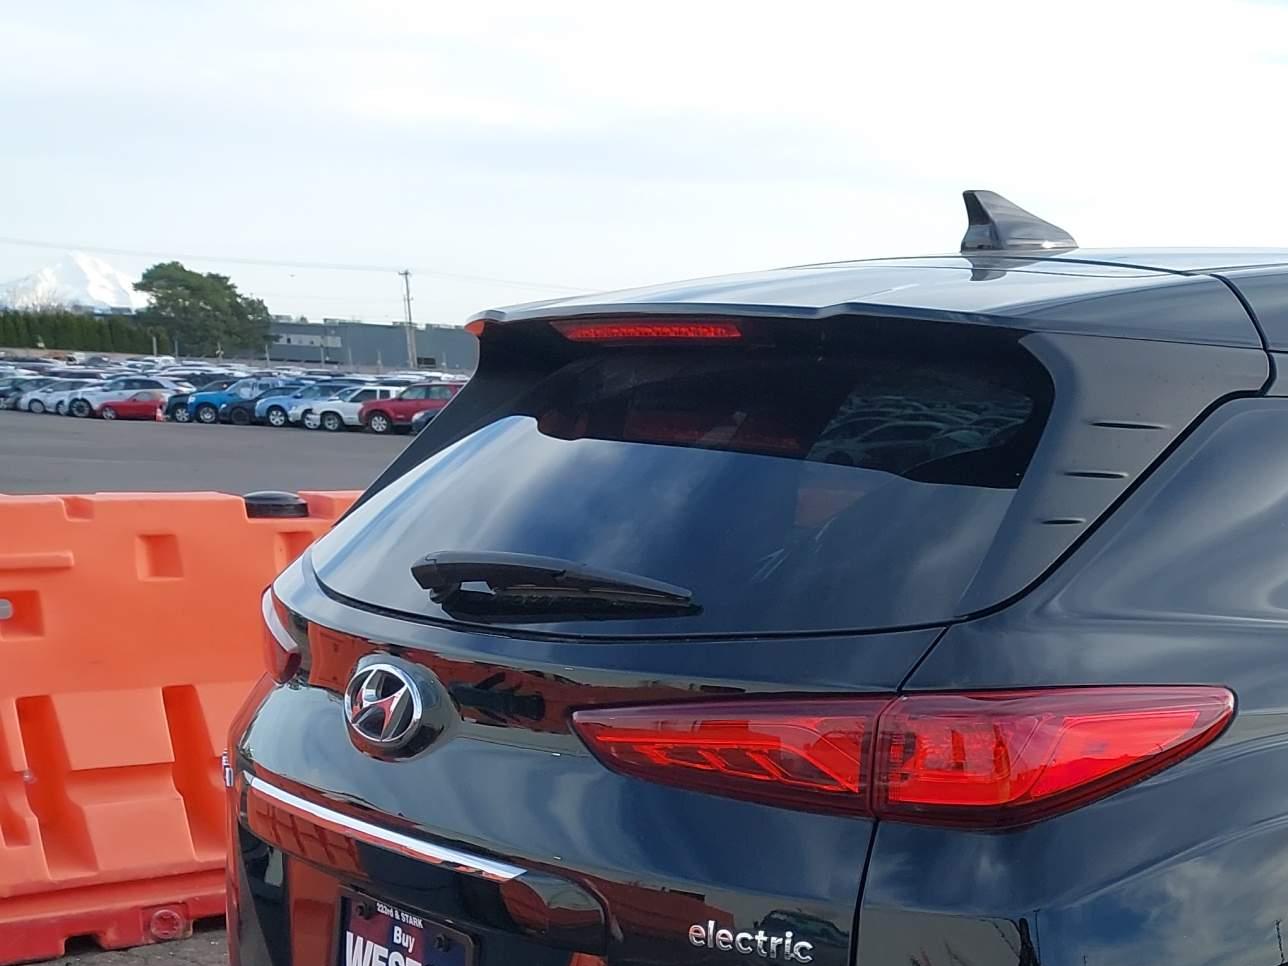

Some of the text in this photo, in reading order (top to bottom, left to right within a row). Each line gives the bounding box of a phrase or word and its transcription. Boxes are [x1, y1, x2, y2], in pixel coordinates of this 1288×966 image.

[400, 912, 424, 929] STARK
[393, 926, 415, 954] Buy
[688, 919, 814, 964] electric
